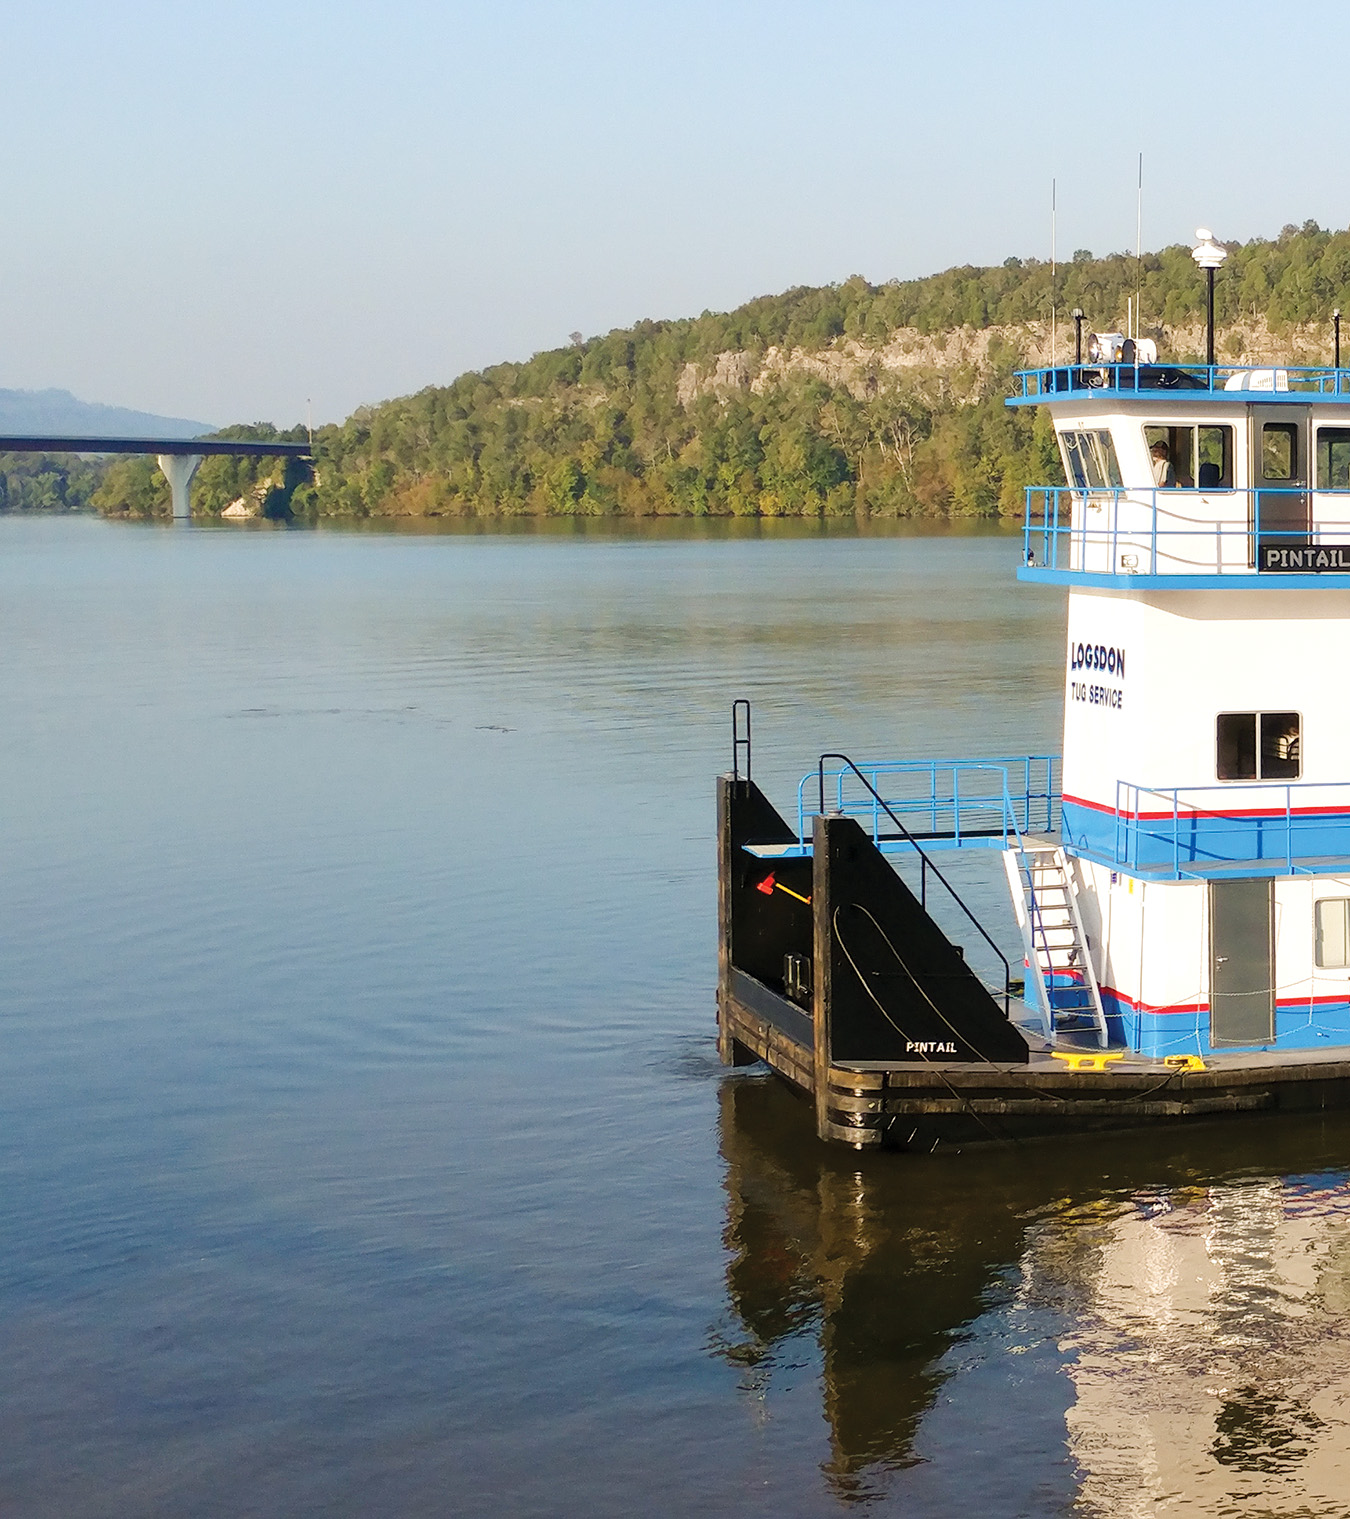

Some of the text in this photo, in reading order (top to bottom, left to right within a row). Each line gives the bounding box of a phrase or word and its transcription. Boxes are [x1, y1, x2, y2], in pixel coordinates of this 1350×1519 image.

[1071, 641, 1126, 680] LOGSDON
[1071, 681, 1123, 710] TUG SERVICE
[905, 1041, 958, 1053] PINTAIL
